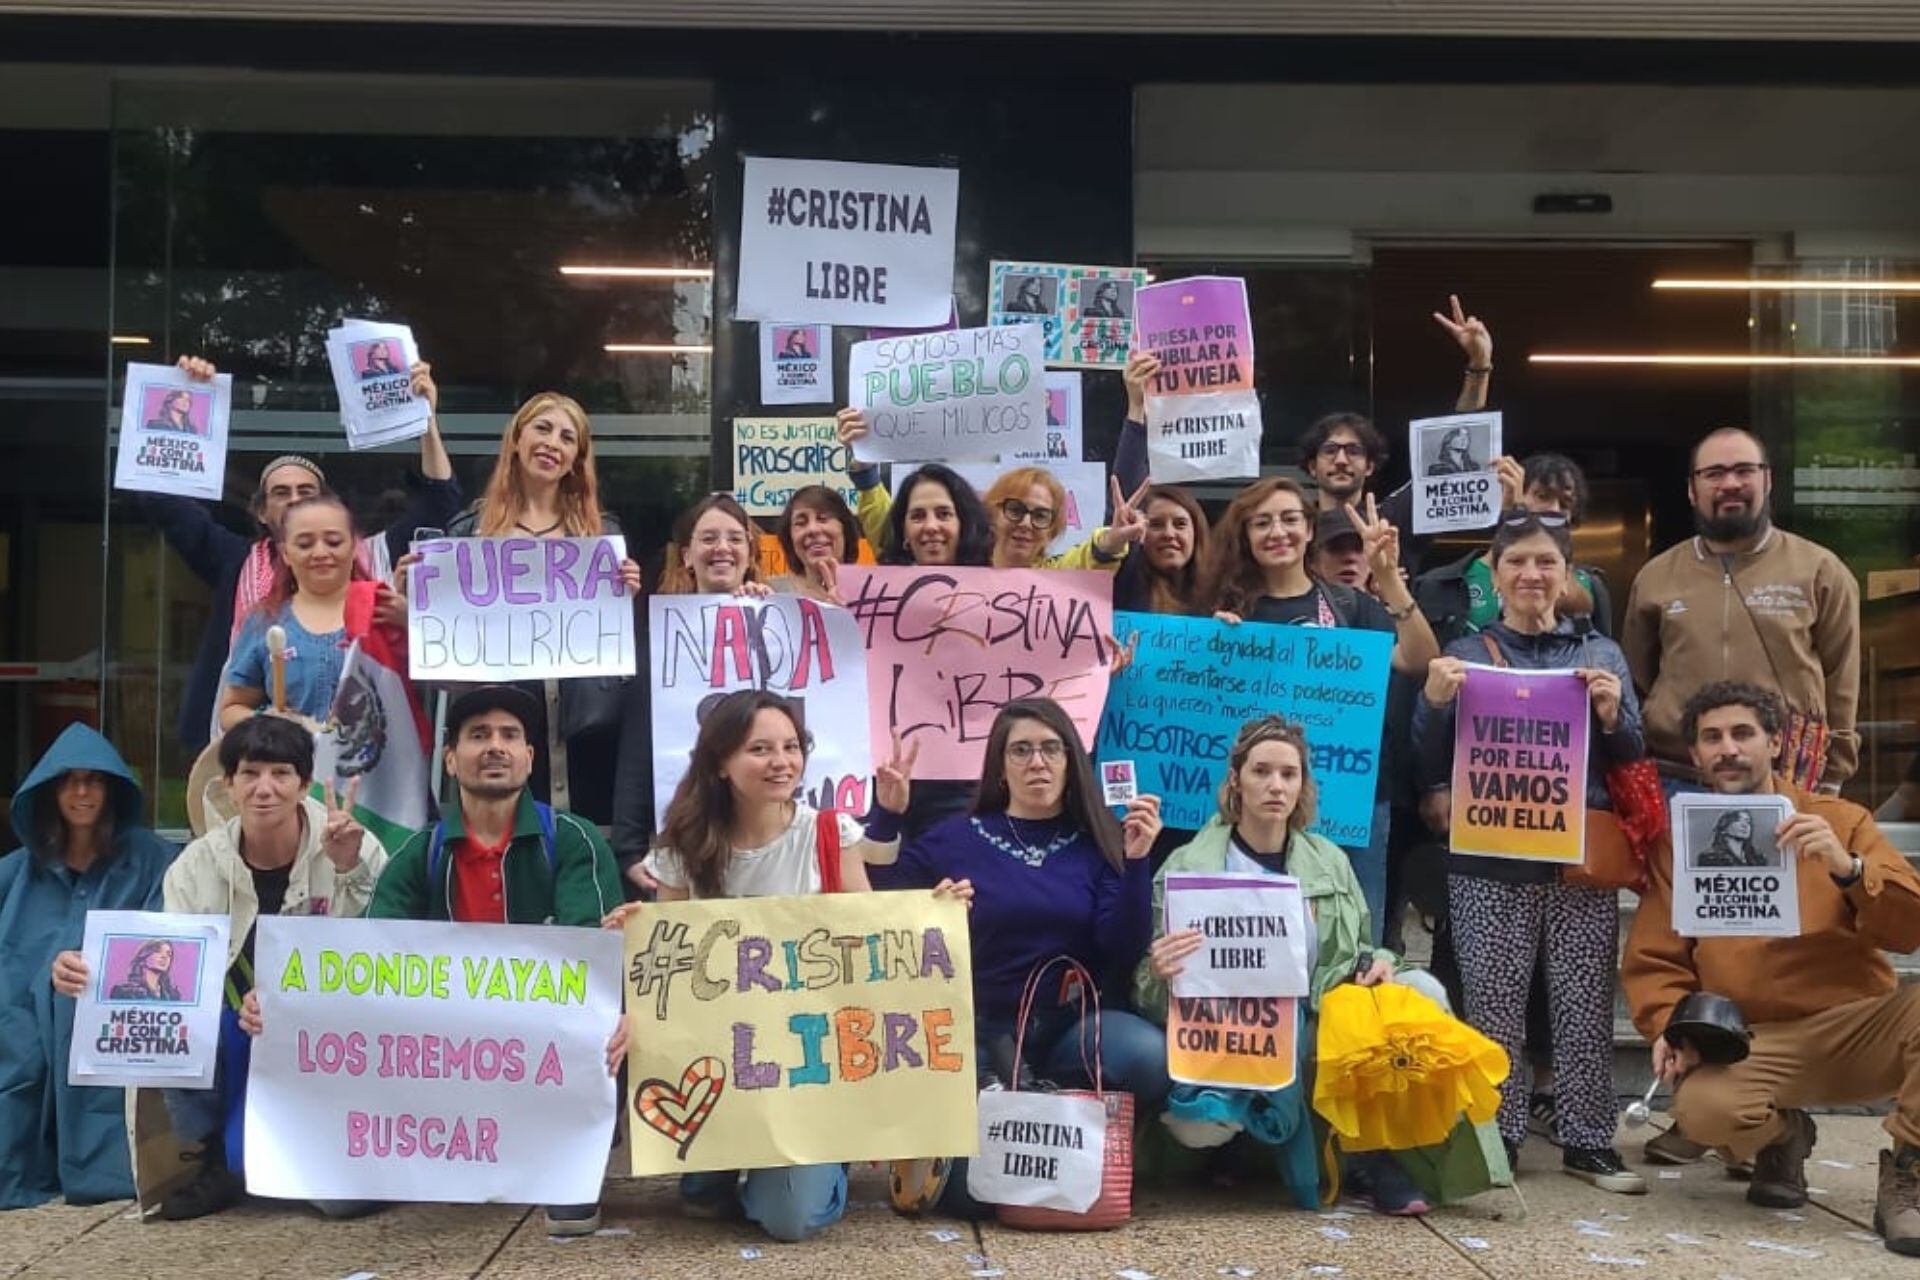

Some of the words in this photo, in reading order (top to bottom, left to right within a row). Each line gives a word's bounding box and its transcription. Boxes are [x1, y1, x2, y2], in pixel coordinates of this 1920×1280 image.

[768, 186, 932, 235] #CRISTINA
[806, 261, 887, 304] LIBRE
[1147, 328, 1199, 348] PRESA
[1203, 324, 1237, 340] POR
[1226, 342, 1238, 359] A
[875, 334, 960, 368] SOMOS
[866, 353, 1030, 407] PUEBLO
[1154, 369, 1179, 393] TU
[1184, 362, 1241, 388] VIEJA
[737, 425, 756, 439] NO
[761, 425, 779, 439] ES
[874, 411, 926, 438] QUE
[942, 402, 1032, 438] MILICOS
[1161, 413, 1245, 437] #CRISTINA
[136, 454, 205, 473] CRISTINA
[1181, 439, 1227, 459] LIBRE
[1426, 479, 1489, 499] MÉXICO
[1426, 502, 1490, 518] CRISTINA
[415, 538, 625, 611] FUERA
[1103, 709, 1229, 761] NOSOTROS
[1473, 715, 1570, 747] VIENEN
[1470, 748, 1508, 768] POR
[1515, 750, 1570, 773] ELLA,
[1158, 761, 1211, 794] VIVA
[1468, 771, 1568, 805] VAMOS
[1466, 804, 1507, 829] CON
[1513, 808, 1566, 832] ELLA
[1695, 874, 1779, 893] MÉXICO
[1696, 905, 1780, 919] CRISTINA
[1211, 948, 1265, 969] LIBRE
[281, 948, 307, 992] A
[320, 950, 450, 999] DONDE
[463, 956, 588, 1005] VAYAN
[111, 1008, 182, 1025] MÉXICO
[1178, 997, 1279, 1028] VAMOS
[128, 1025, 161, 1037] CON
[1177, 1027, 1218, 1053] CON
[1225, 1031, 1277, 1057] ELLA
[96, 1037, 190, 1055] CRISTINA
[299, 1029, 367, 1077] LOS
[377, 1033, 525, 1082] IREMOS
[535, 1041, 563, 1086] A
[732, 1006, 963, 1090] LIBRE
[347, 1110, 499, 1163] BUSCAR
[988, 1120, 1084, 1149] #CRISTINA
[1003, 1152, 1059, 1181] LIBRE
